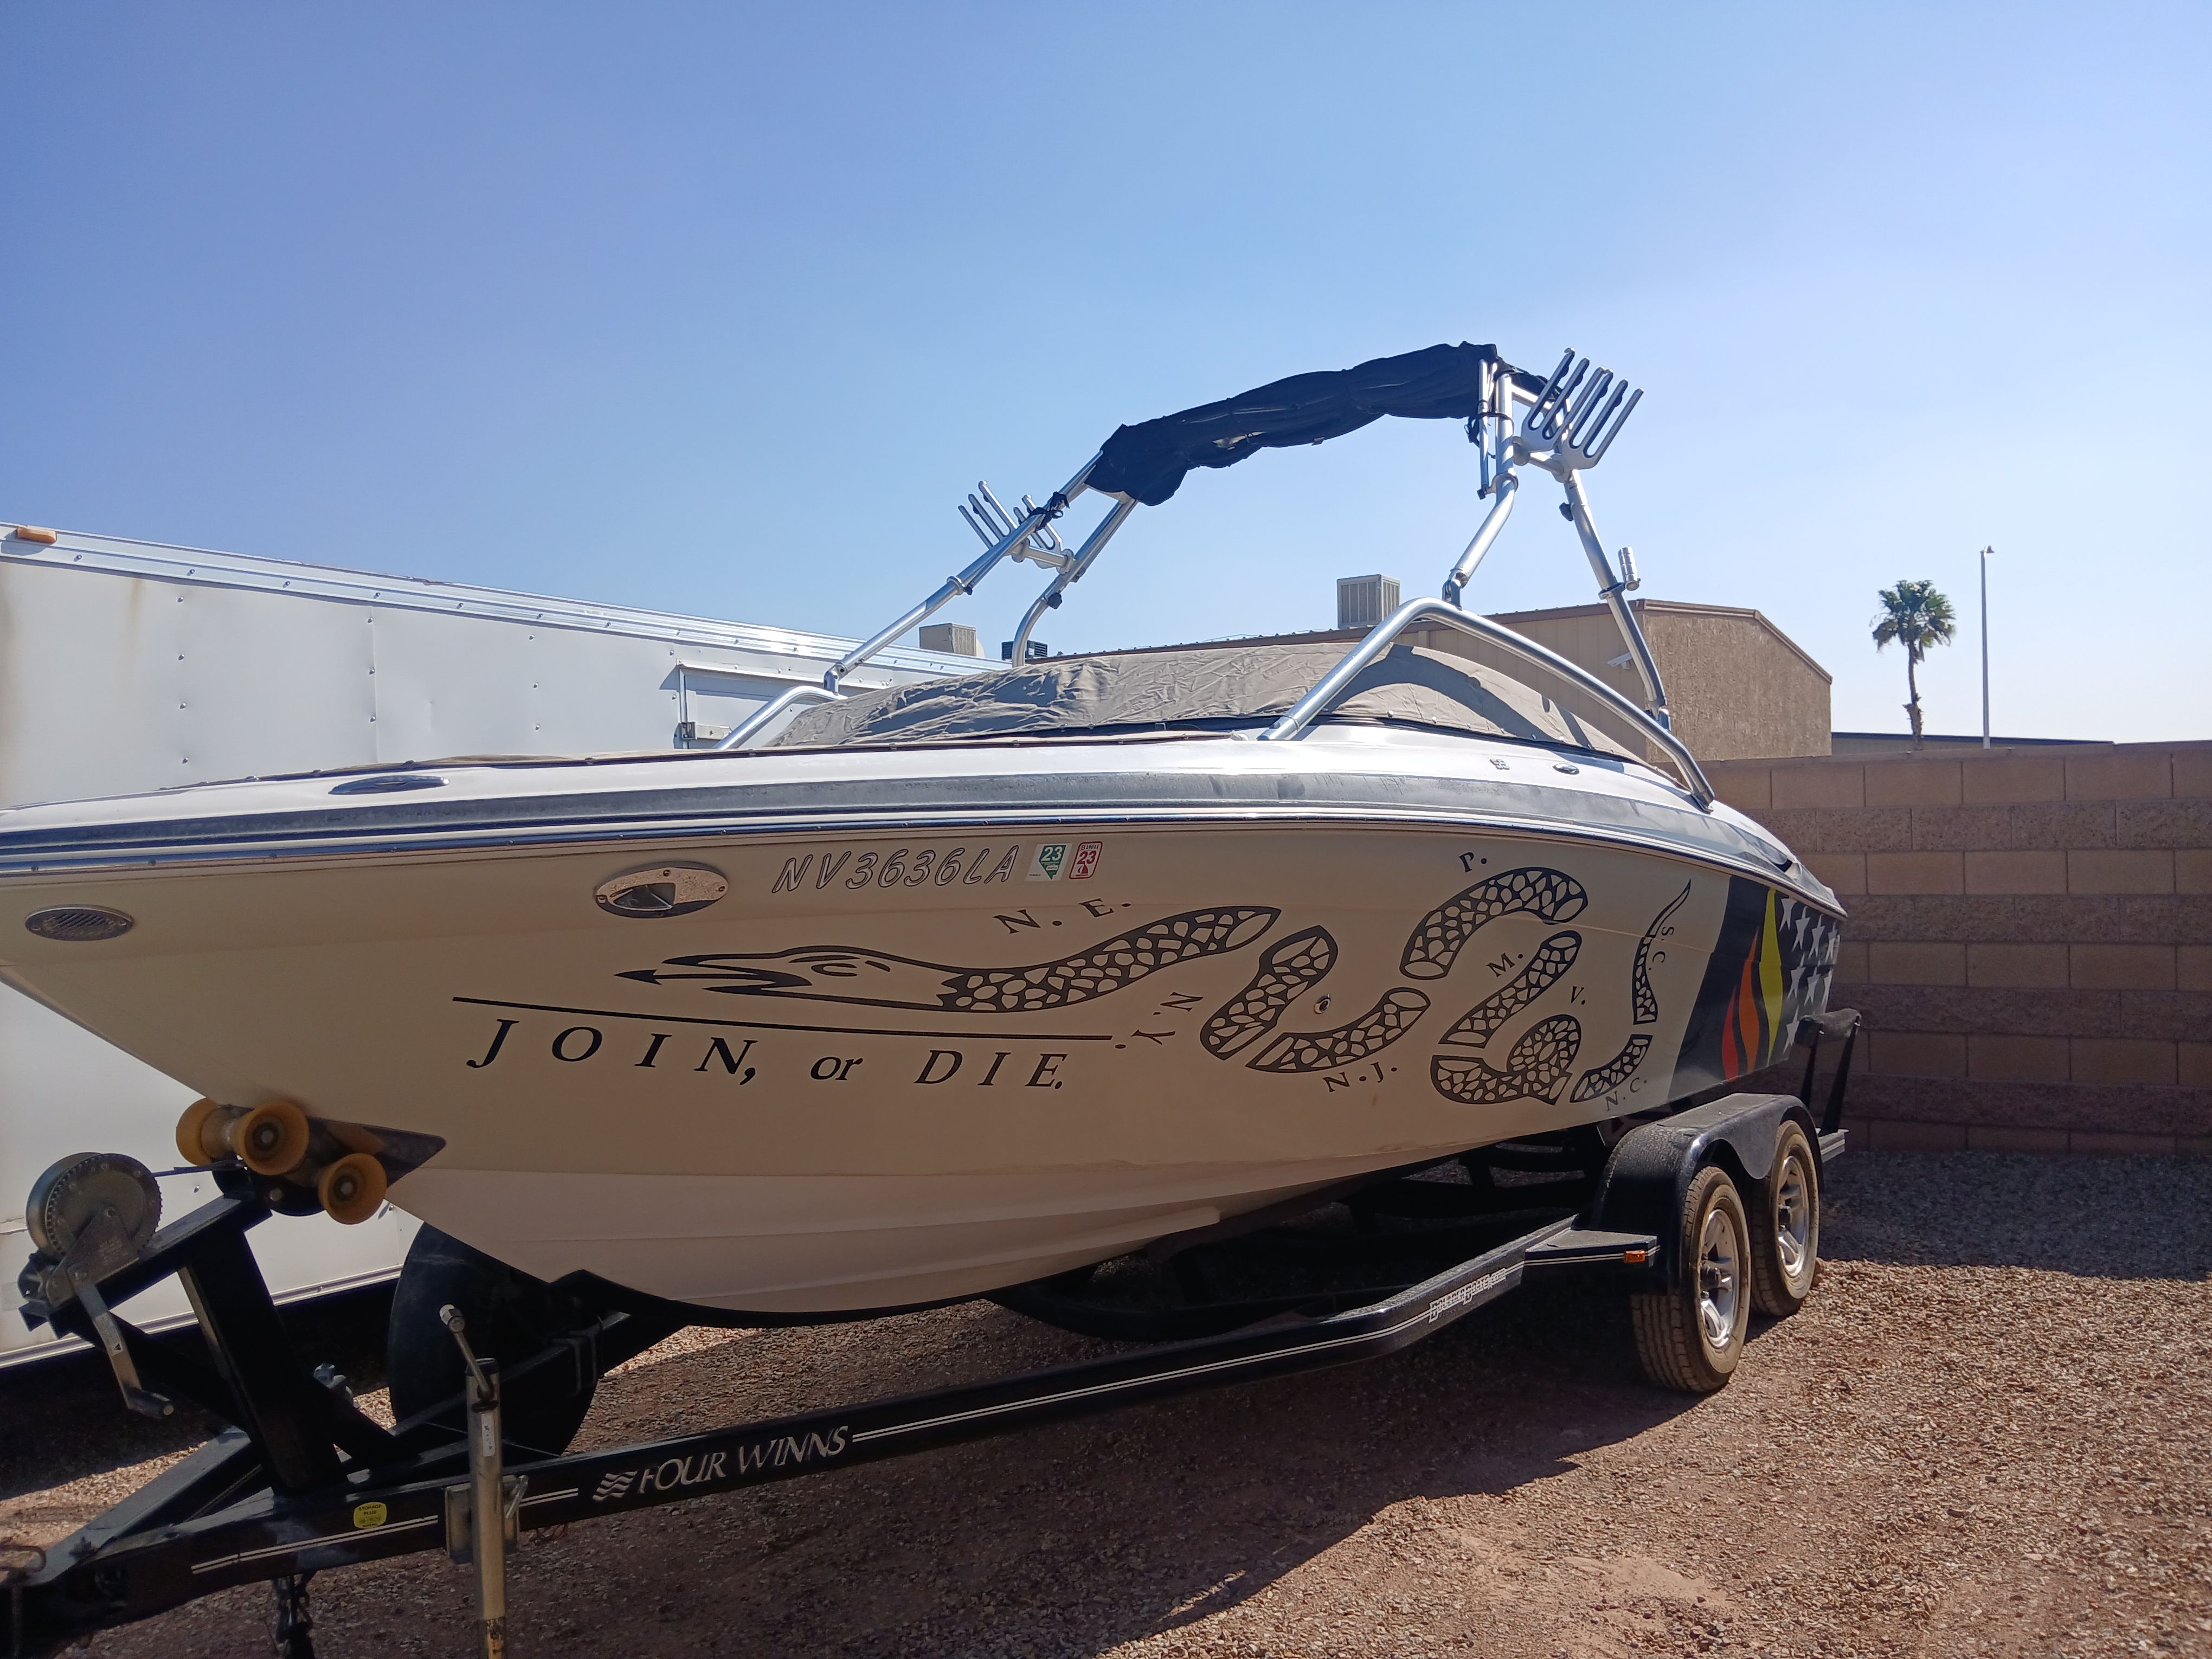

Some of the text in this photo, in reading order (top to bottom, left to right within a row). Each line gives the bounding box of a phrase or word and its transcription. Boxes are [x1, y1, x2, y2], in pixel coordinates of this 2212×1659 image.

[1040, 846, 1063, 861] 23
[1077, 851, 1097, 865] 23
[1458, 852, 1487, 873] P.
[771, 845, 1019, 893] NV3636LA
[1486, 952, 1523, 978] M.
[1570, 986, 1586, 1005] V.
[466, 1019, 1068, 1089] JOIN, or DIE.
[638, 1425, 849, 1495] FOUR WINNS
